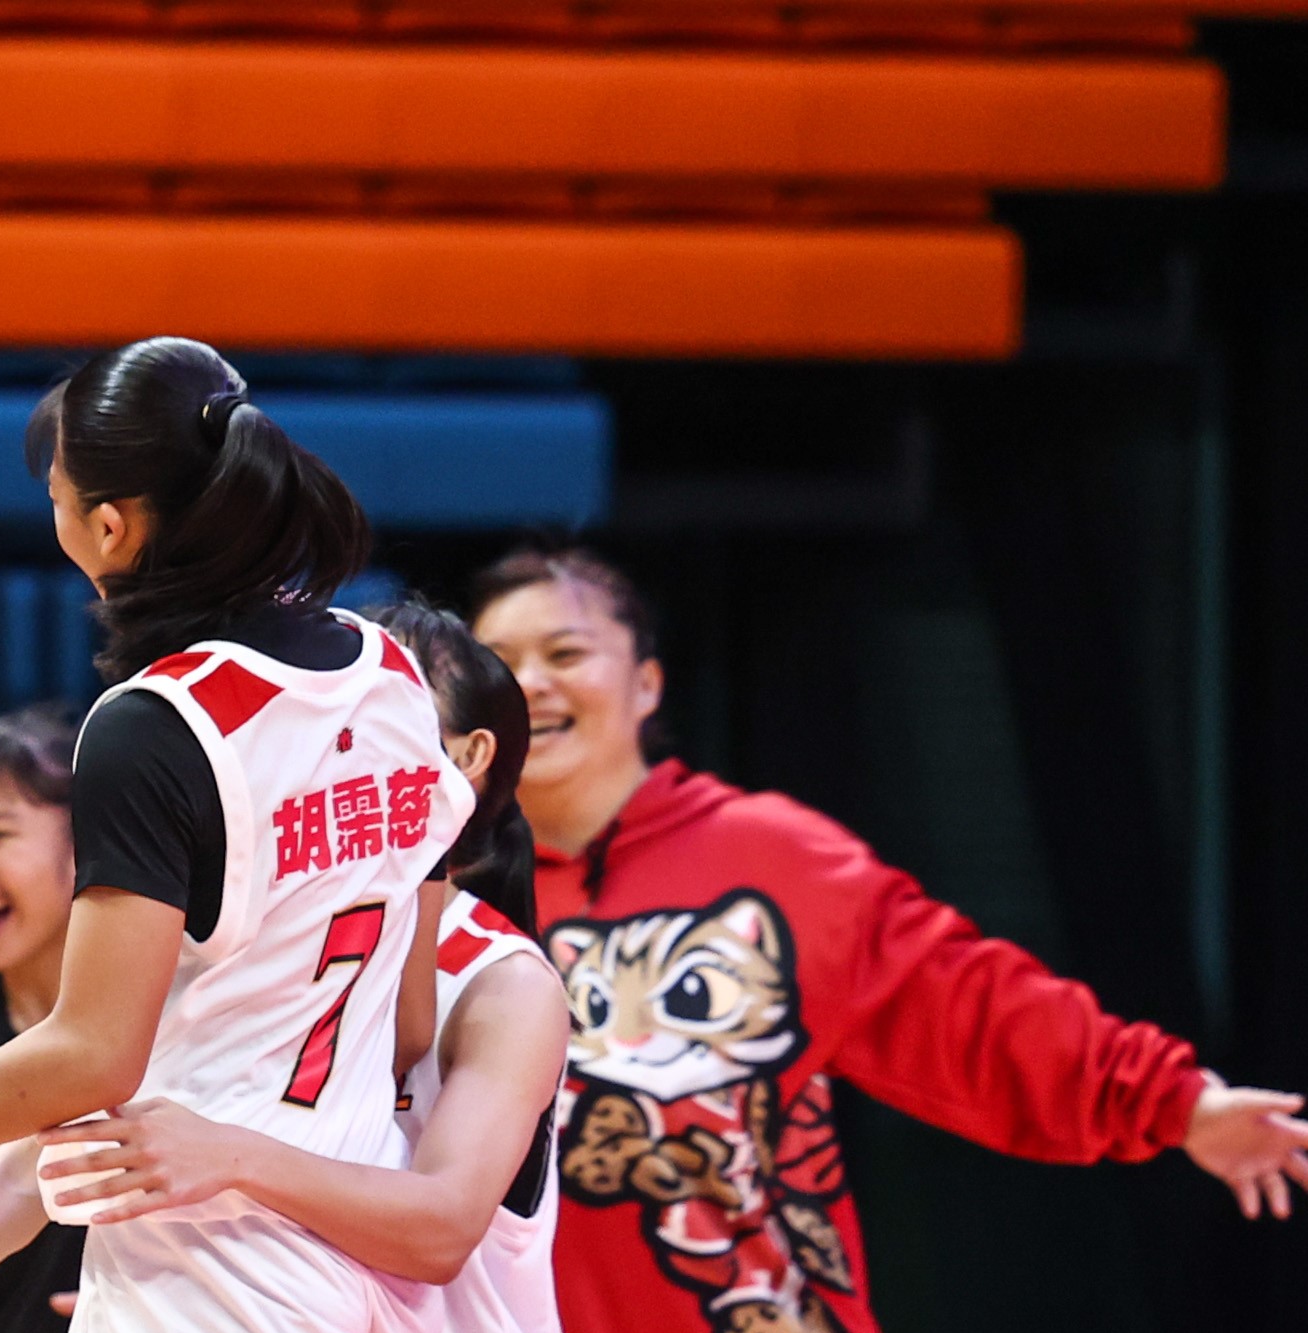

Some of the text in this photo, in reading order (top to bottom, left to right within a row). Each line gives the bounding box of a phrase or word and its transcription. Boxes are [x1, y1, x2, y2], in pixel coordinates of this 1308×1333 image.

[272, 765, 441, 882] 胡霈慈
[280, 899, 387, 1110] 7
